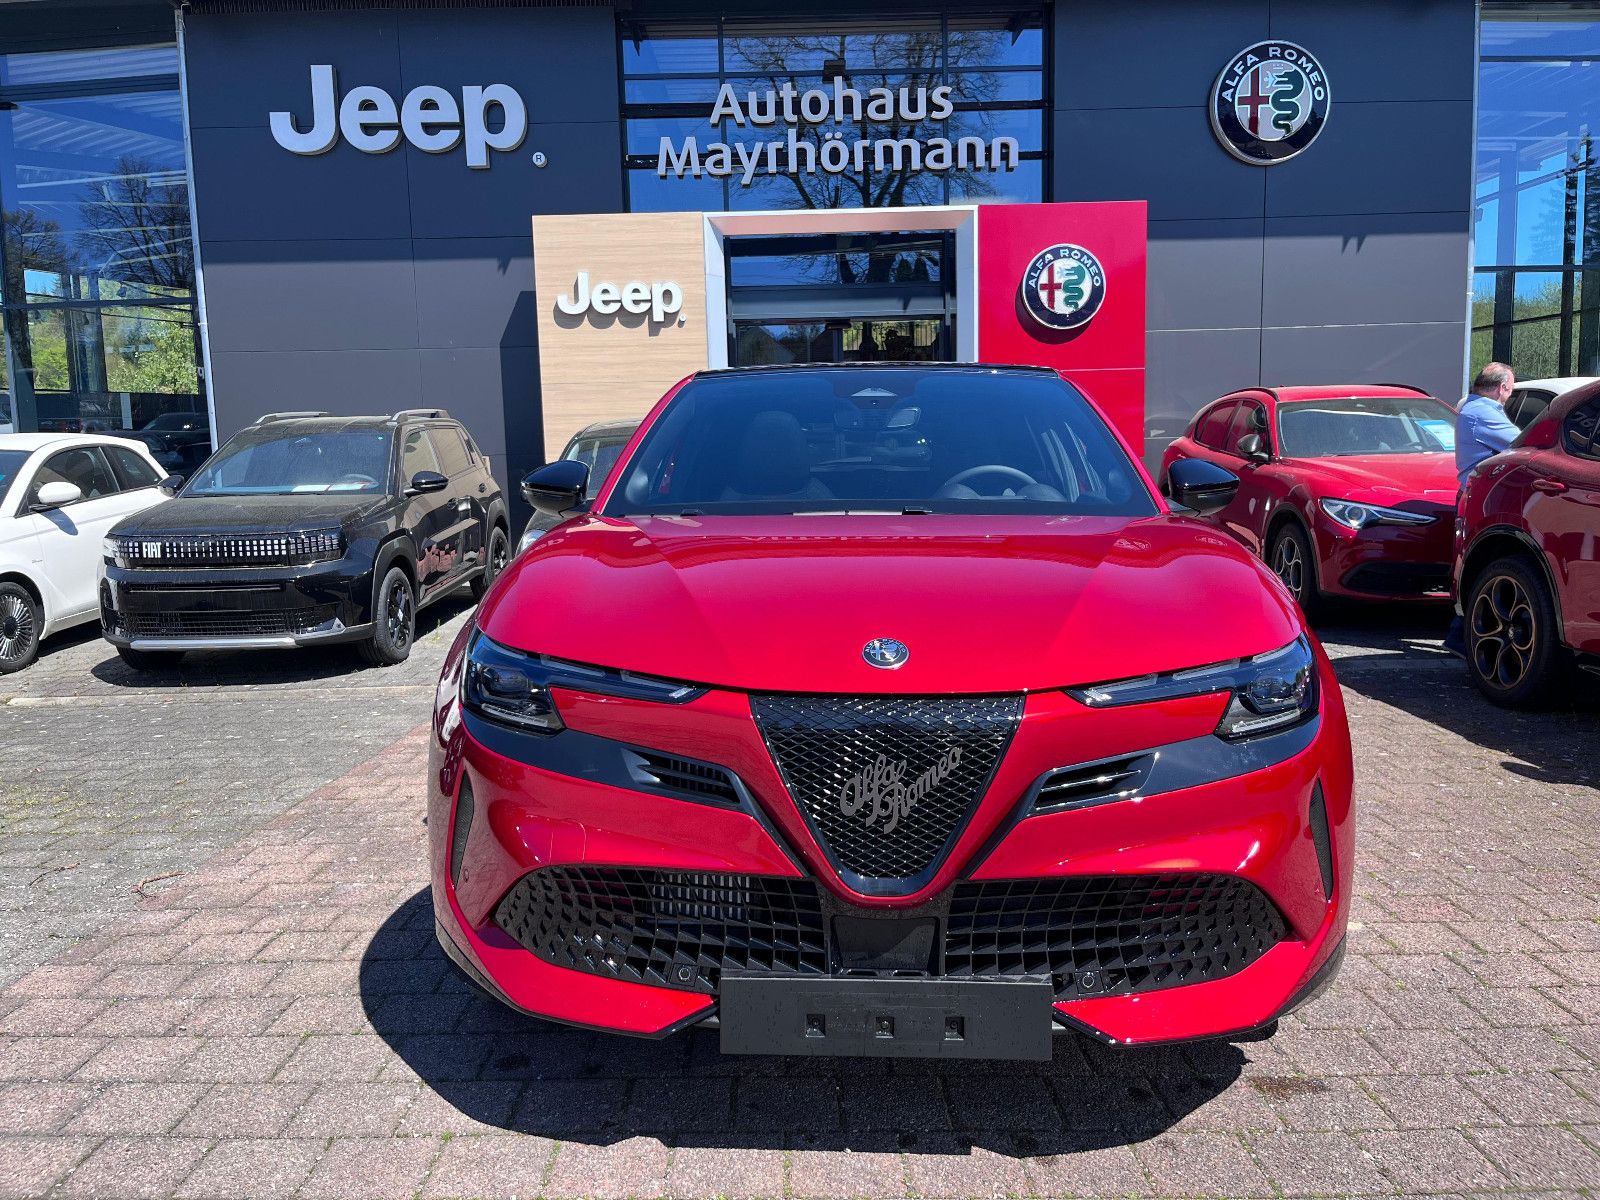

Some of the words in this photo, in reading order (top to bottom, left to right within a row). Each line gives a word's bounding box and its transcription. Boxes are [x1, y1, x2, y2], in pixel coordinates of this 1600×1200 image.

[1221, 53, 1260, 103] ALFA
[1268, 46, 1325, 101] ROMEO
[269, 64, 528, 169] Jeep
[709, 75, 954, 126] Autohaus
[657, 128, 1020, 186] Mayrhörmann
[1028, 253, 1055, 288] ALFA
[1059, 248, 1101, 287] ROMEO
[557, 271, 683, 322] Jeep
[142, 541, 162, 558] FIAT
